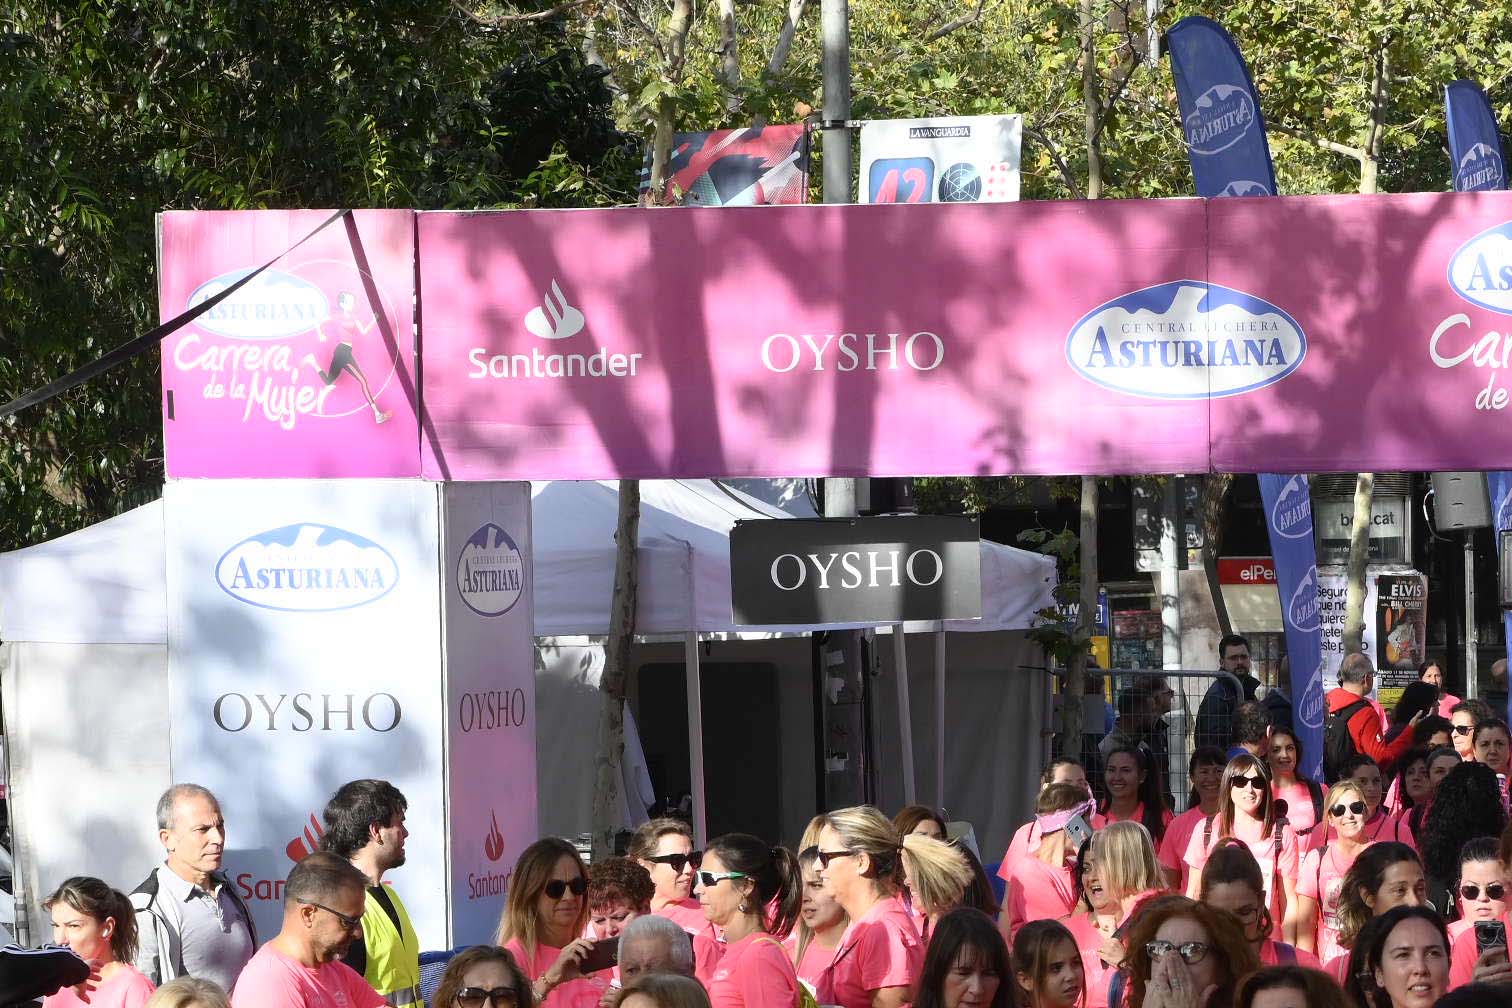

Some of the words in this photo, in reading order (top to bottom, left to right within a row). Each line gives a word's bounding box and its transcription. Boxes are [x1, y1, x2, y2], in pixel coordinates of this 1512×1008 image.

[922, 128, 969, 138] VANGUARDIA
[1121, 321, 1193, 333] CENTRAL
[174, 333, 291, 371] Carrera
[468, 348, 641, 378] Santander
[761, 332, 944, 373] OYSHO
[1086, 326, 1288, 367] ASTURIANA
[203, 375, 224, 399] de
[230, 376, 245, 399] la
[243, 368, 336, 430] Mujer
[1476, 369, 1508, 410] de
[1341, 512, 1395, 527] b.cat
[231, 556, 385, 590] ASTURIANA
[463, 559, 520, 593] ASTURIANA
[771, 549, 943, 591] OYSHO
[1391, 584, 1421, 597] ELVIS
[213, 692, 402, 733] OYSHO
[459, 687, 526, 733] OYSHO
